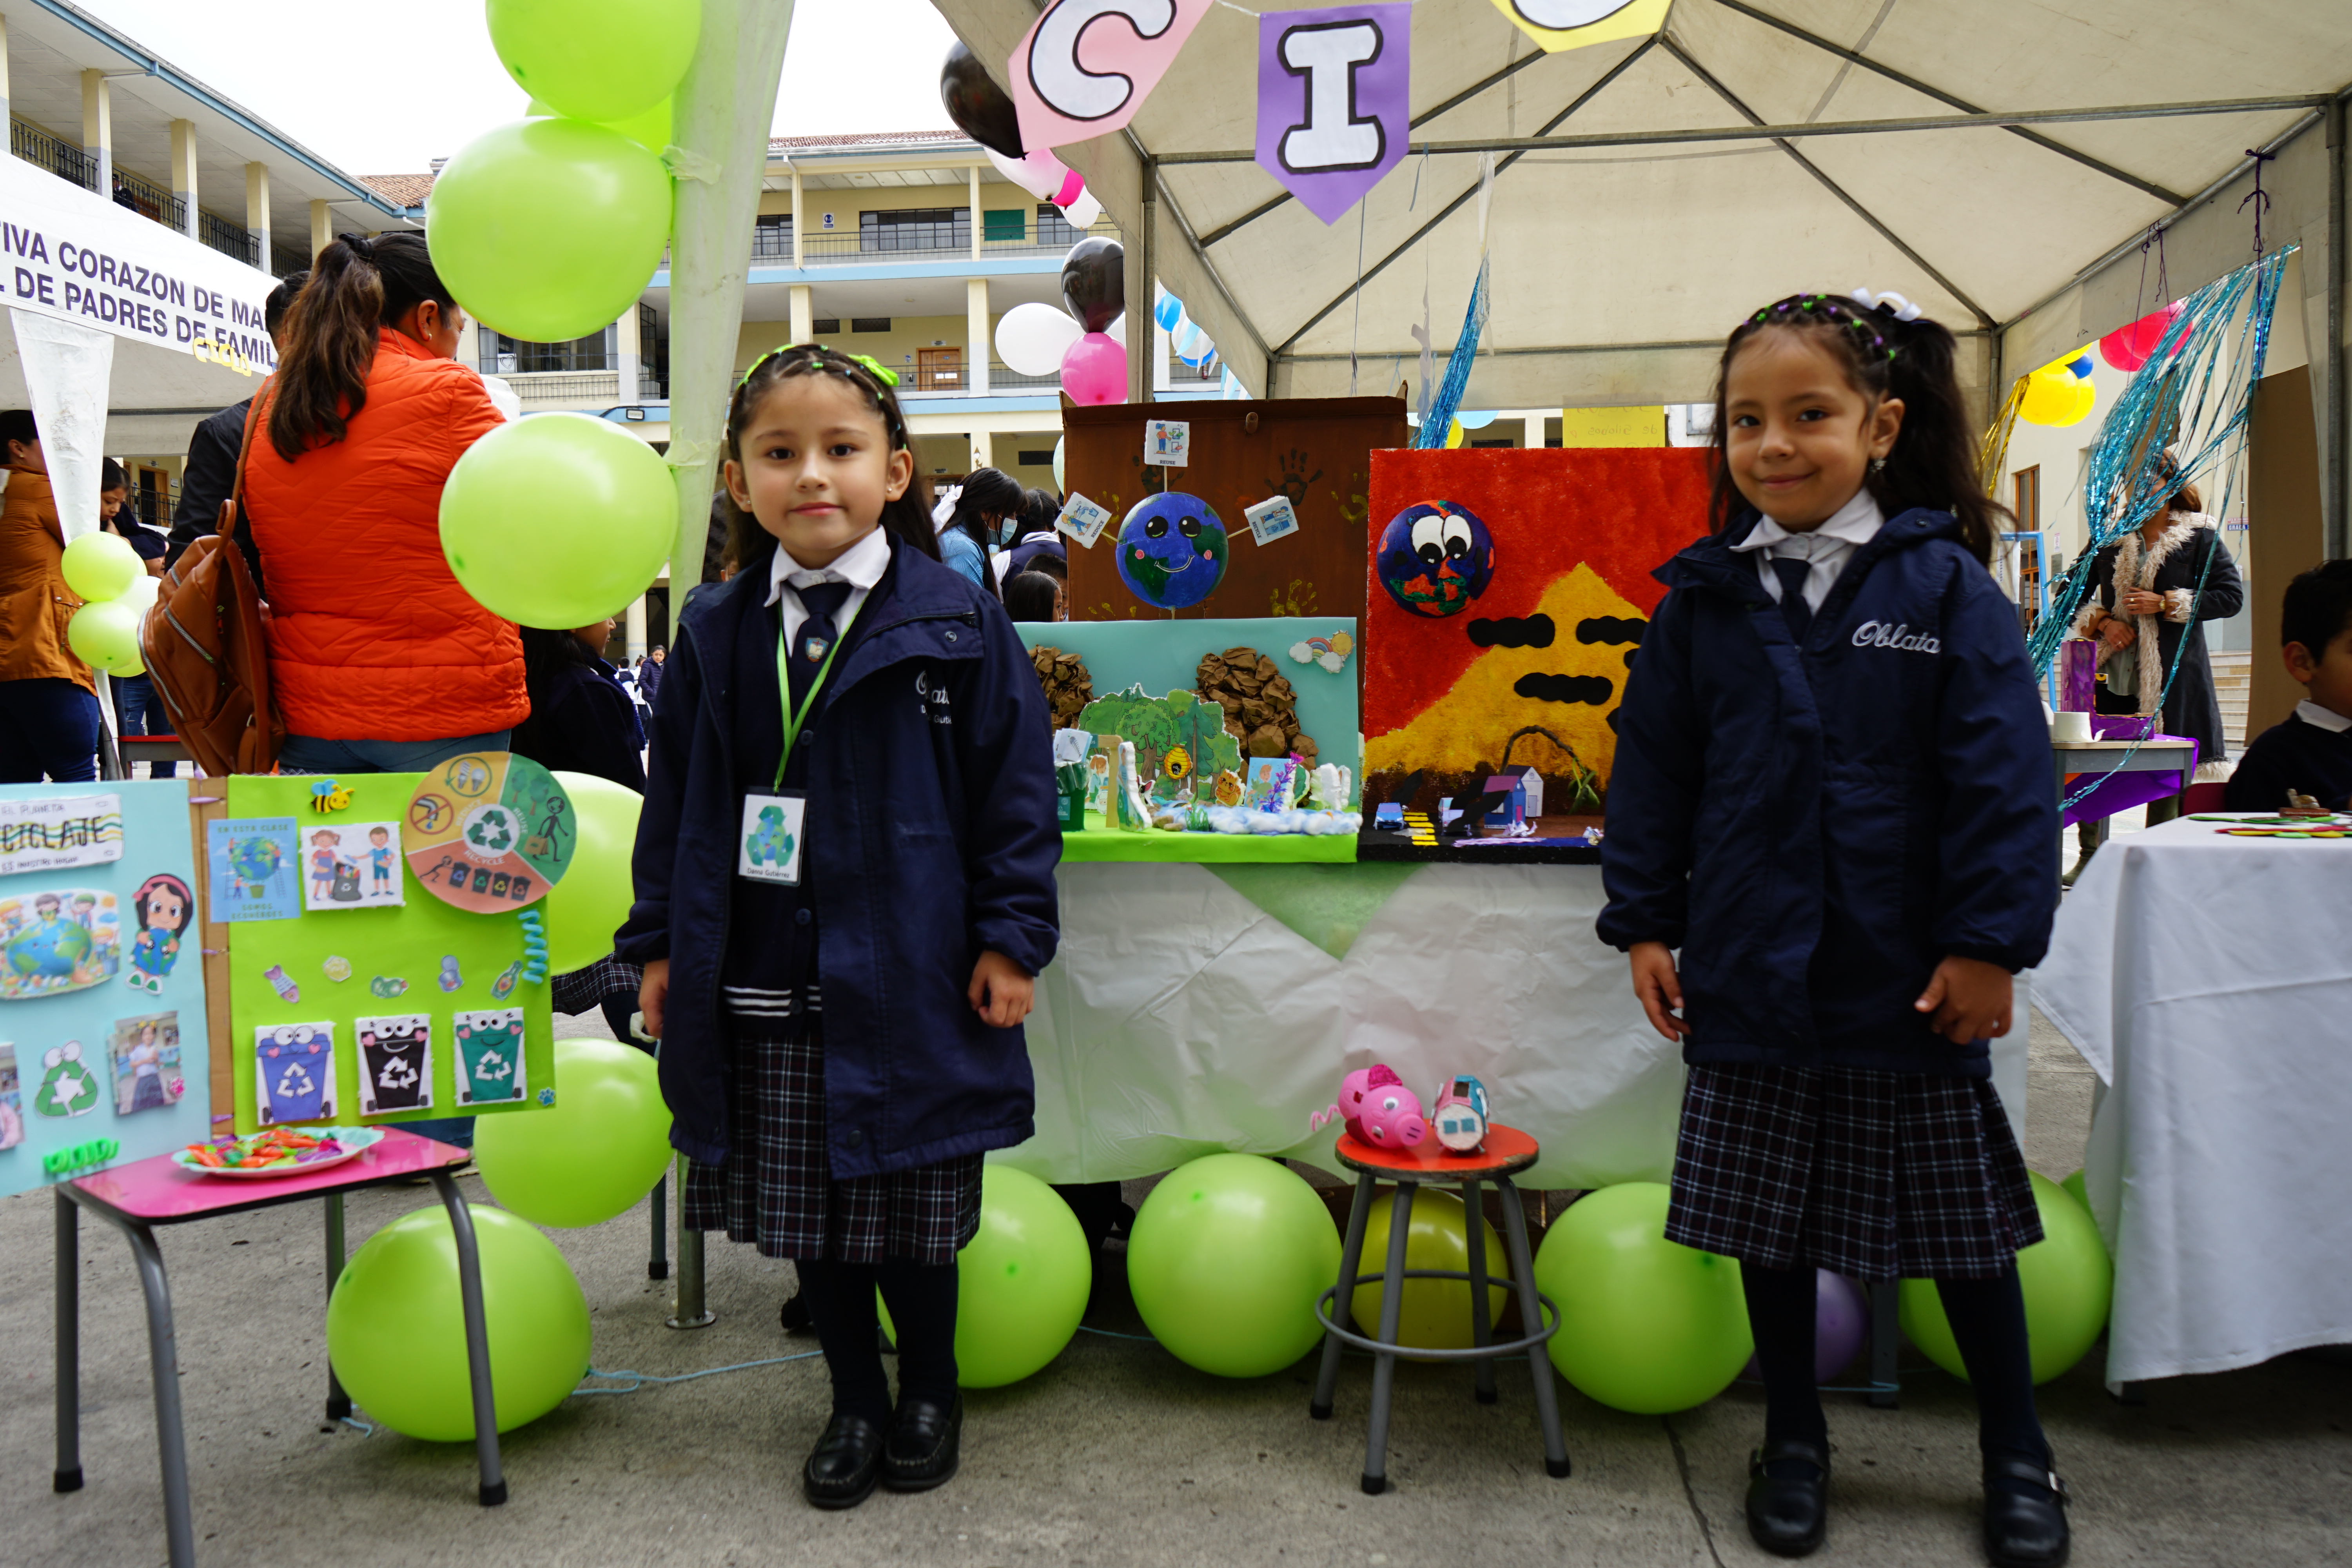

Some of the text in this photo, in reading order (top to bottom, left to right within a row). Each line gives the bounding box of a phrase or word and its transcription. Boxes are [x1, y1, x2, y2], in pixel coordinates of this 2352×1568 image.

[0, 220, 269, 333] IVA CORAZON DE MA
[15, 266, 55, 306] DE
[65, 281, 167, 337] PADRES
[176, 315, 207, 348] DE
[193, 338, 252, 377] CICLO
[1091, 520, 1104, 538] REDUCE
[1252, 521, 1261, 539] RECYCLE
[1852, 619, 1940, 654] Oblata
[0, 816, 106, 851] CICLAJE
[513, 806, 528, 834] REUSE
[464, 849, 506, 865] RECYCLE
[765, 869, 790, 878] Gutiérrez
